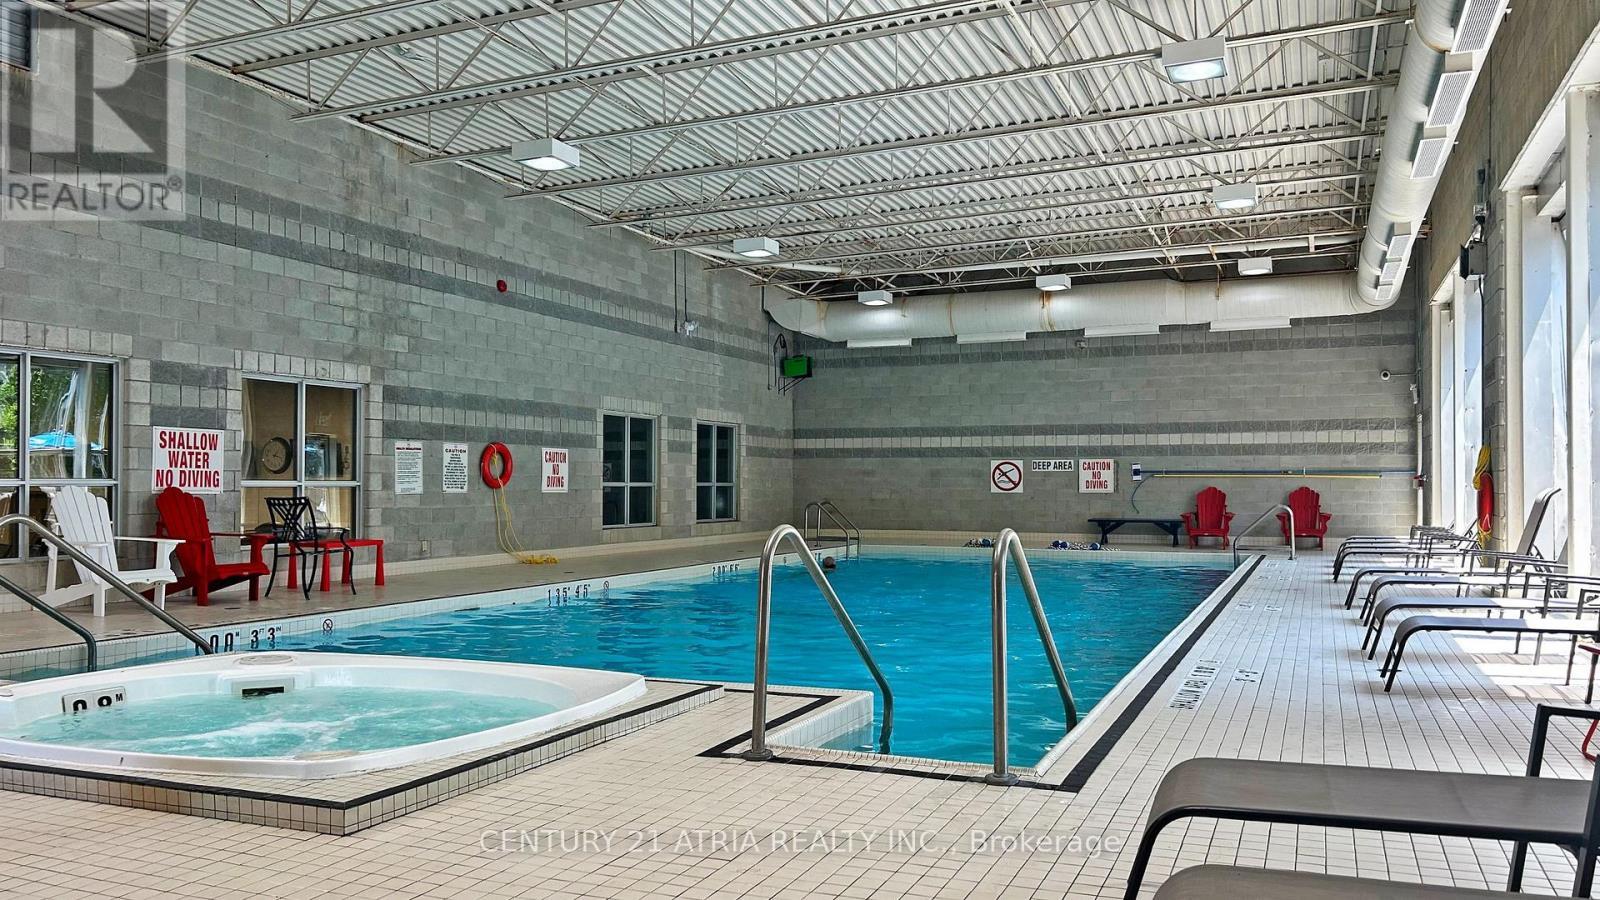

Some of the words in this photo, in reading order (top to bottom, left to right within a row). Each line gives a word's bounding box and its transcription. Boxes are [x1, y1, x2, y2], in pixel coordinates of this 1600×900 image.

[159, 430, 218, 450] SHALLOW
[168, 450, 210, 469] WATER
[544, 450, 566, 464] CAUTION
[552, 464, 560, 476] NO
[1032, 461, 1051, 470] DEEP
[1053, 461, 1073, 470] AREA
[1082, 462, 1111, 470] CAUTION
[156, 470, 174, 488] NO
[178, 470, 220, 488] DIVING
[1092, 471, 1101, 479] NO
[546, 476, 564, 488] DIVING
[1086, 480, 1108, 489] DIVING
